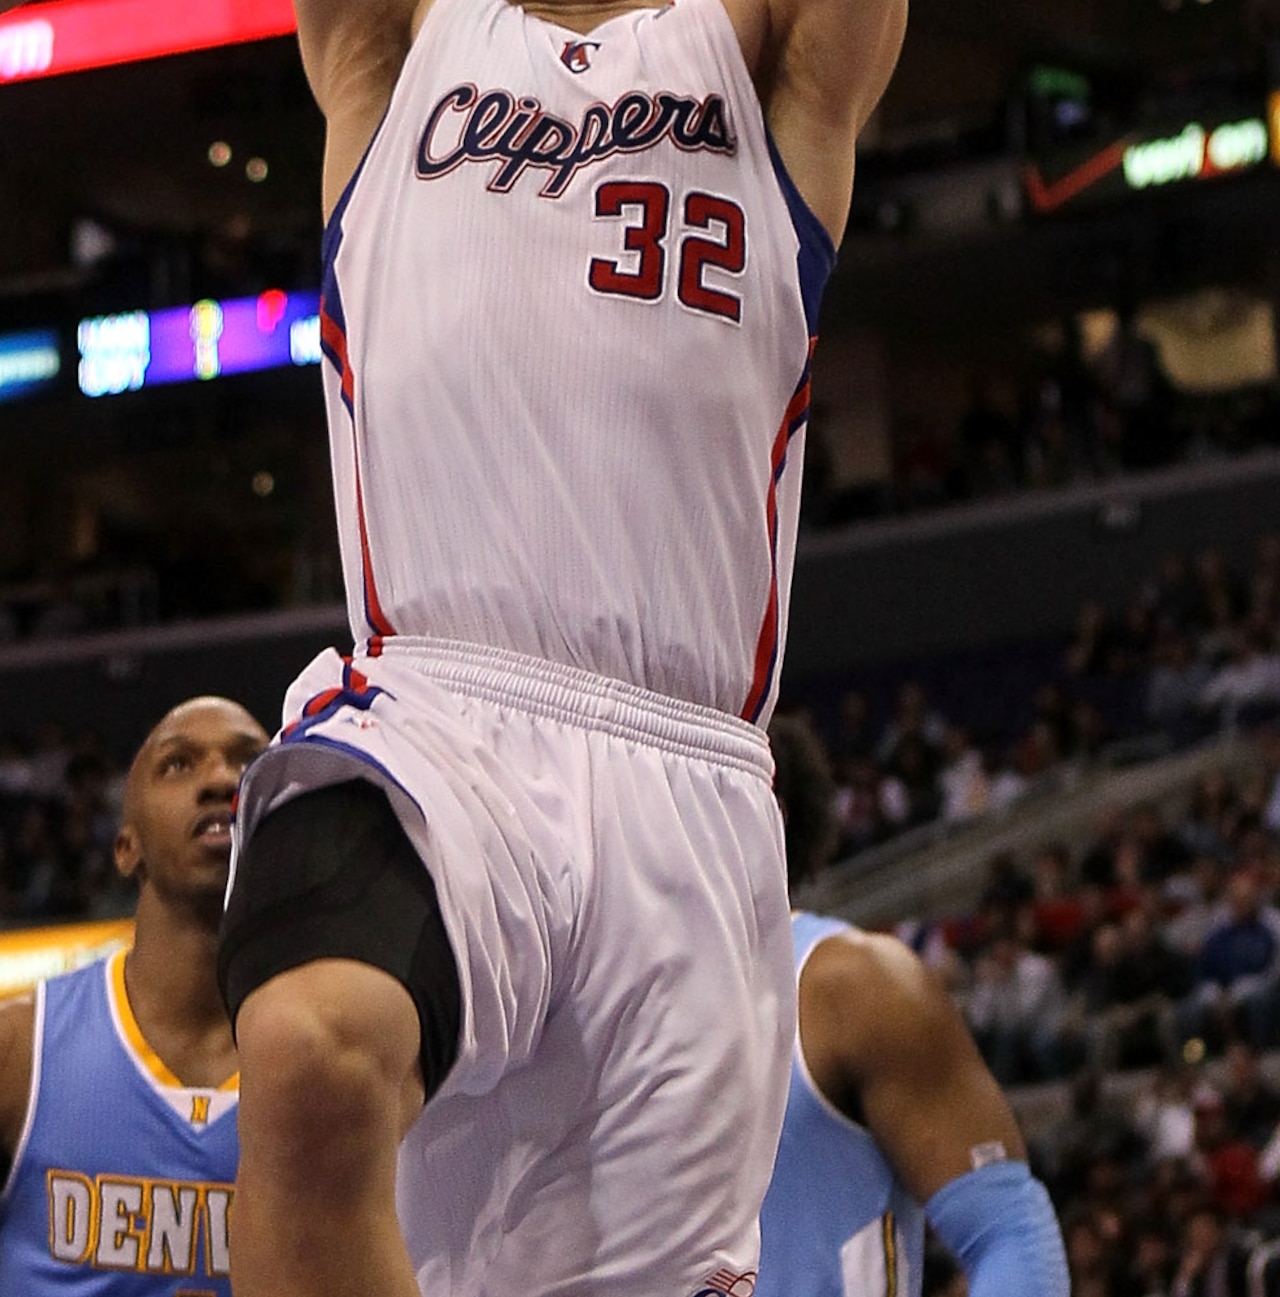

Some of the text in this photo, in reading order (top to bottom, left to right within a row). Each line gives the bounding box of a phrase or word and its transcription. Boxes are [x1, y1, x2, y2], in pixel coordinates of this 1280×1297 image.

[415, 82, 739, 199] Clippers
[586, 180, 748, 328] 32
[47, 1168, 233, 1278] DEN
